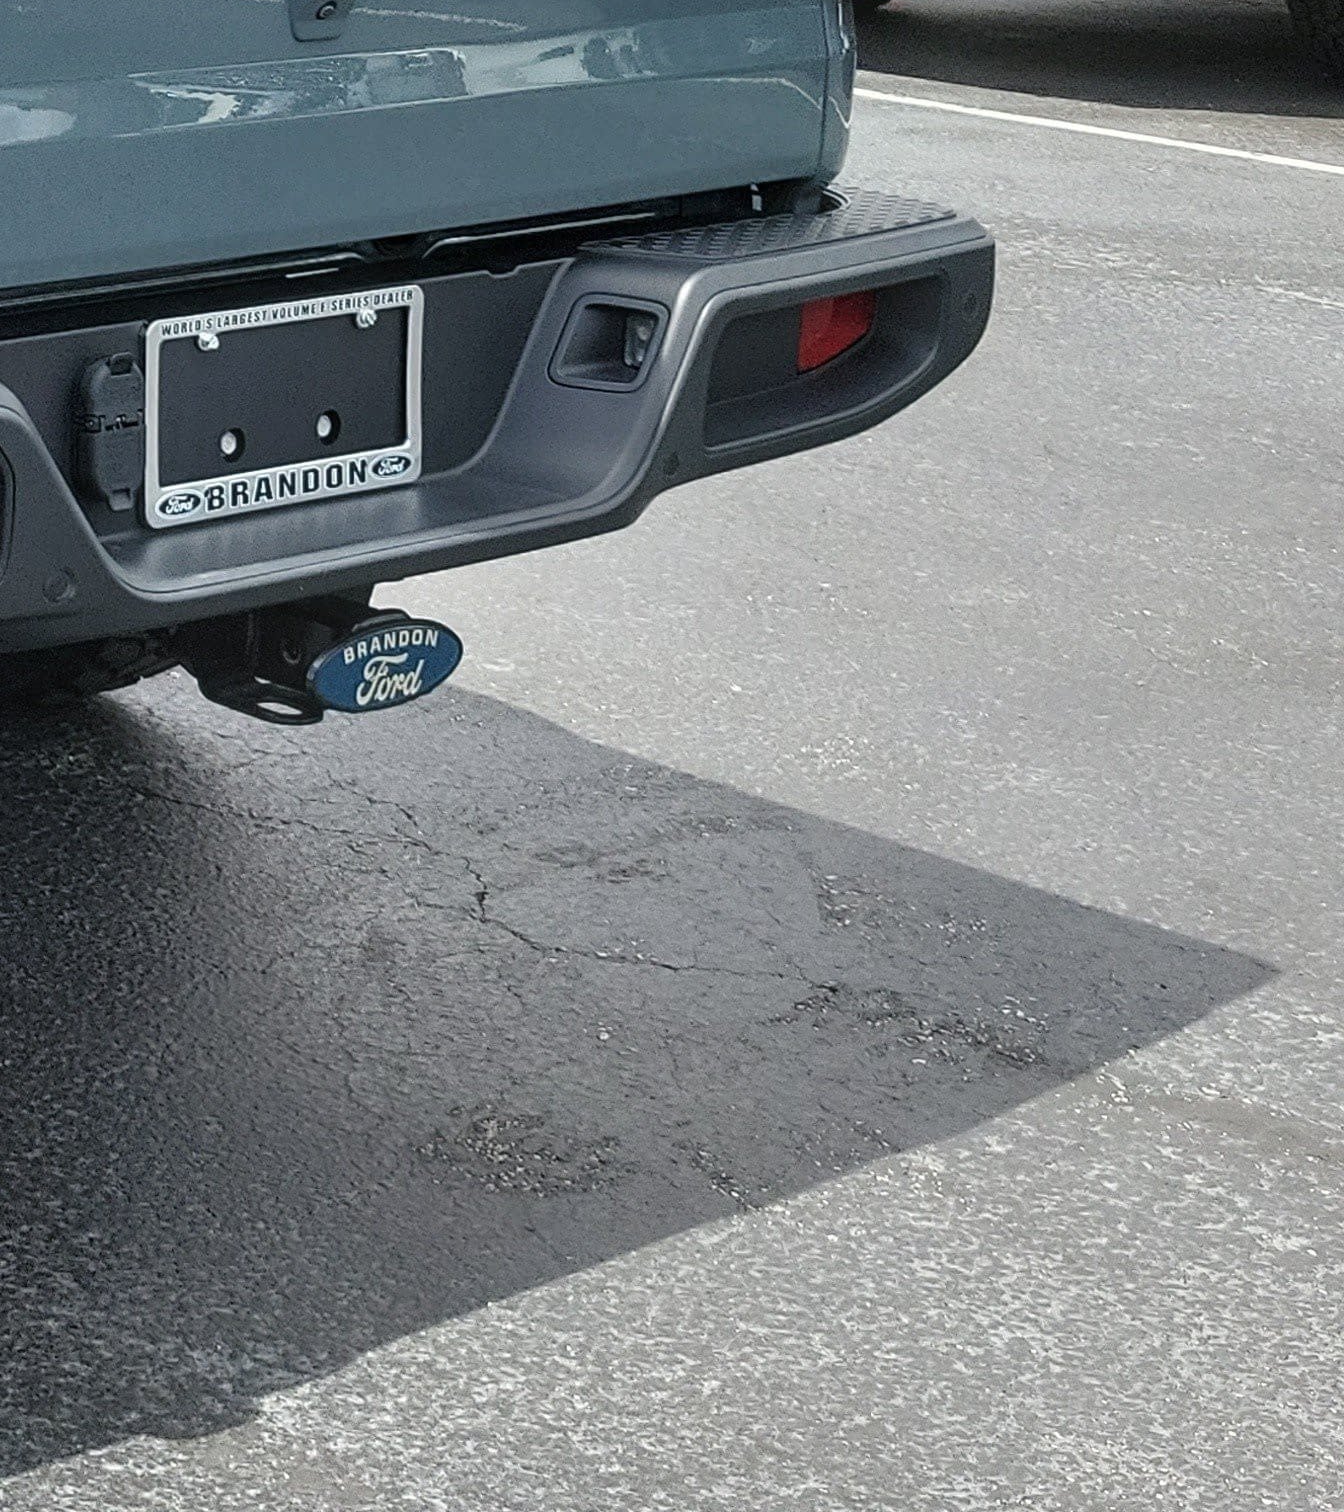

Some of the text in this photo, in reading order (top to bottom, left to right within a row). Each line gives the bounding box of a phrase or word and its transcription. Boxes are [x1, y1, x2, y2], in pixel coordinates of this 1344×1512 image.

[217, 310, 267, 328] LARGEST
[272, 303, 316, 319] VOLUME
[331, 295, 369, 311] SERIES
[373, 289, 413, 305] DEALER
[165, 455, 408, 514] Ford BRANDON Ford
[343, 629, 439, 665] BRANDON
[356, 653, 424, 705] Ford
